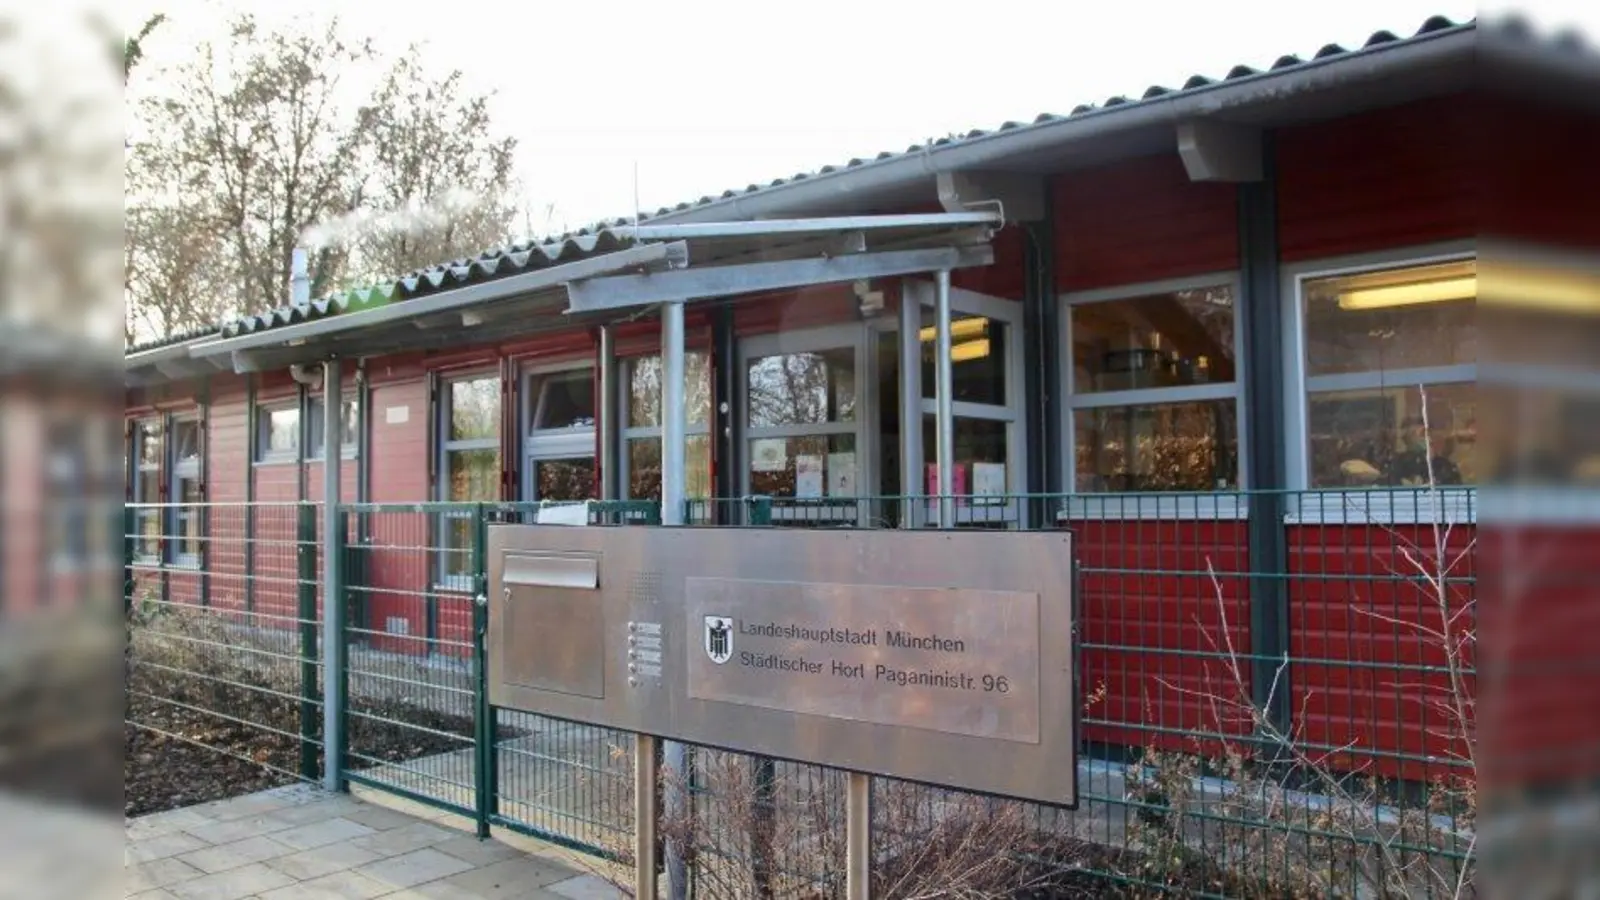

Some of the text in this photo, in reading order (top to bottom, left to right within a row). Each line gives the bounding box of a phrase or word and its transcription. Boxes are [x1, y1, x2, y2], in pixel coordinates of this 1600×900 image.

[739, 620, 965, 652] Landeshauptstadt München
[740, 651, 1010, 693] Städtischer Hort Paganinistr. 96
